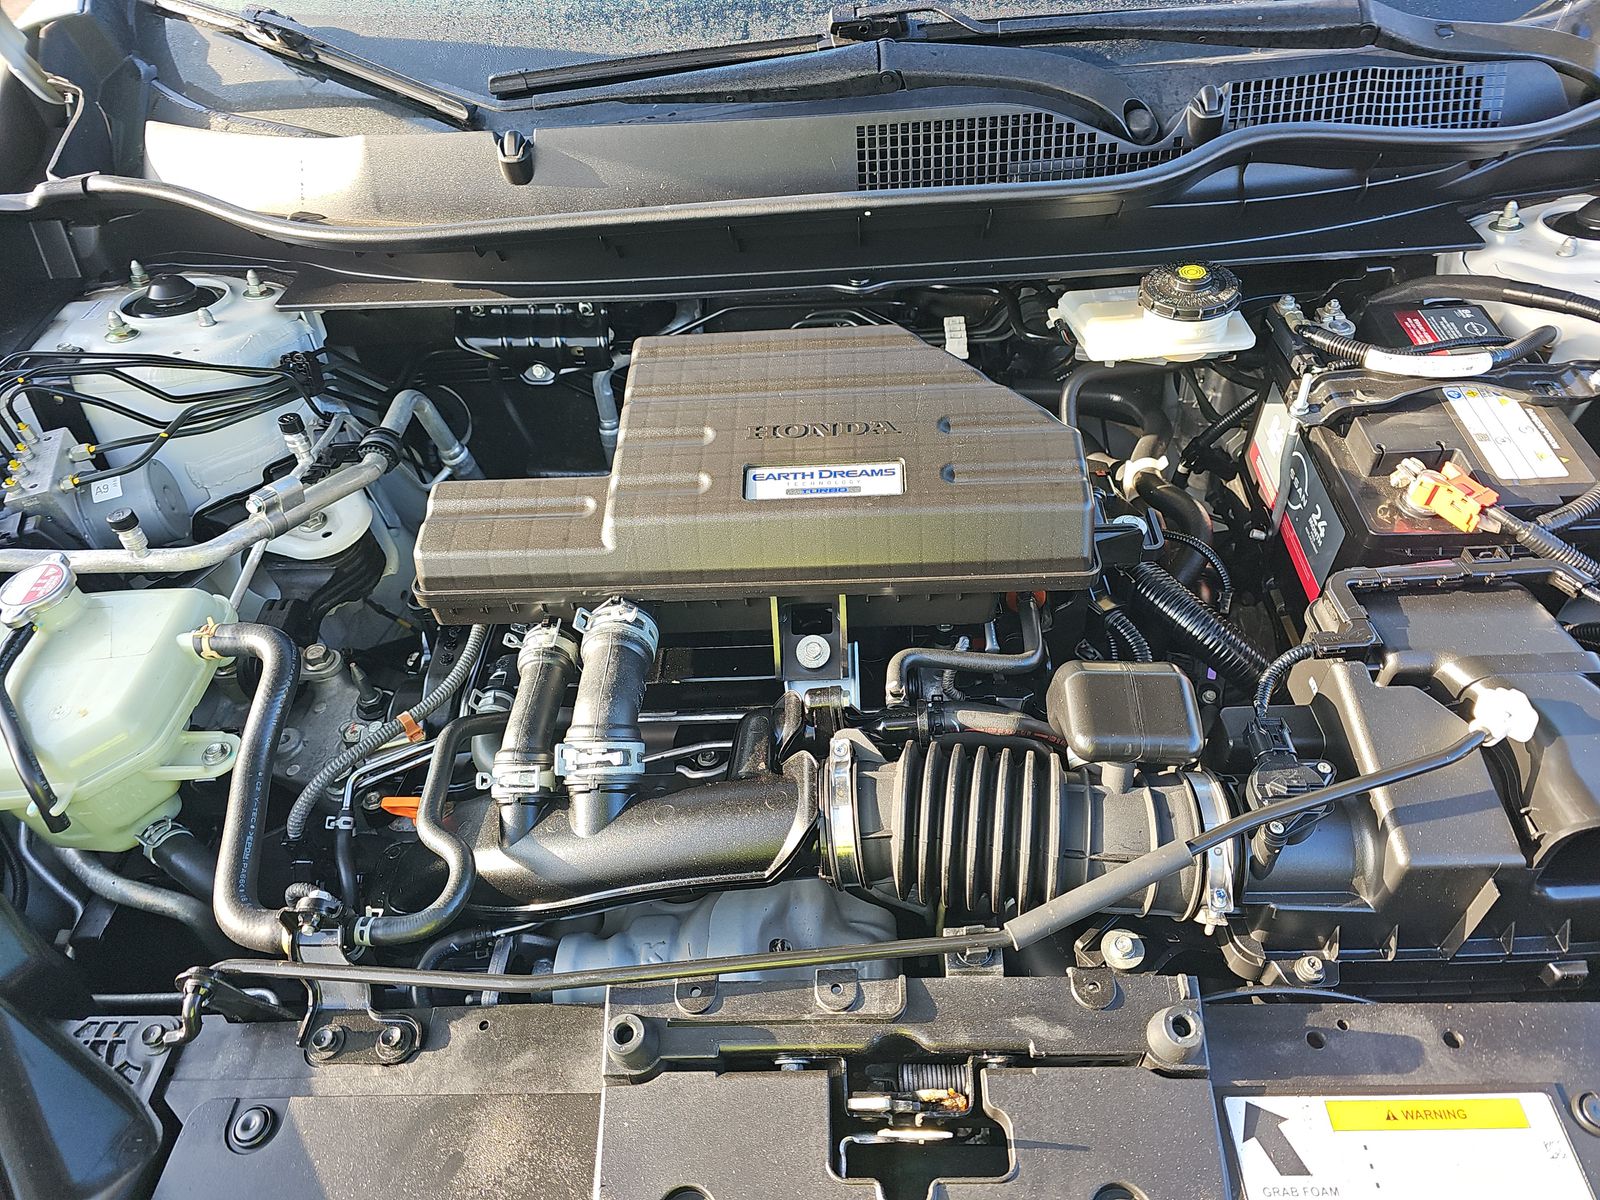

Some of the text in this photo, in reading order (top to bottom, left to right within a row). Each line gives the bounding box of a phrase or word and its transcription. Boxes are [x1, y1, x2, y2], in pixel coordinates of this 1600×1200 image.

[745, 420, 902, 440] HONDA
[752, 467, 896, 482] EARTH DREAMS
[786, 479, 861, 487] TECHNOLOGY
[95, 483, 109, 496] A9
[1290, 467, 1308, 508] SSAN
[1311, 503, 1328, 538] 24
[1308, 516, 1323, 548] MONTH
[250, 796, 262, 824] Y-TEC
[1401, 1108, 1468, 1121] WARNING
[1262, 1186, 1340, 1198] GRAB FOAM
